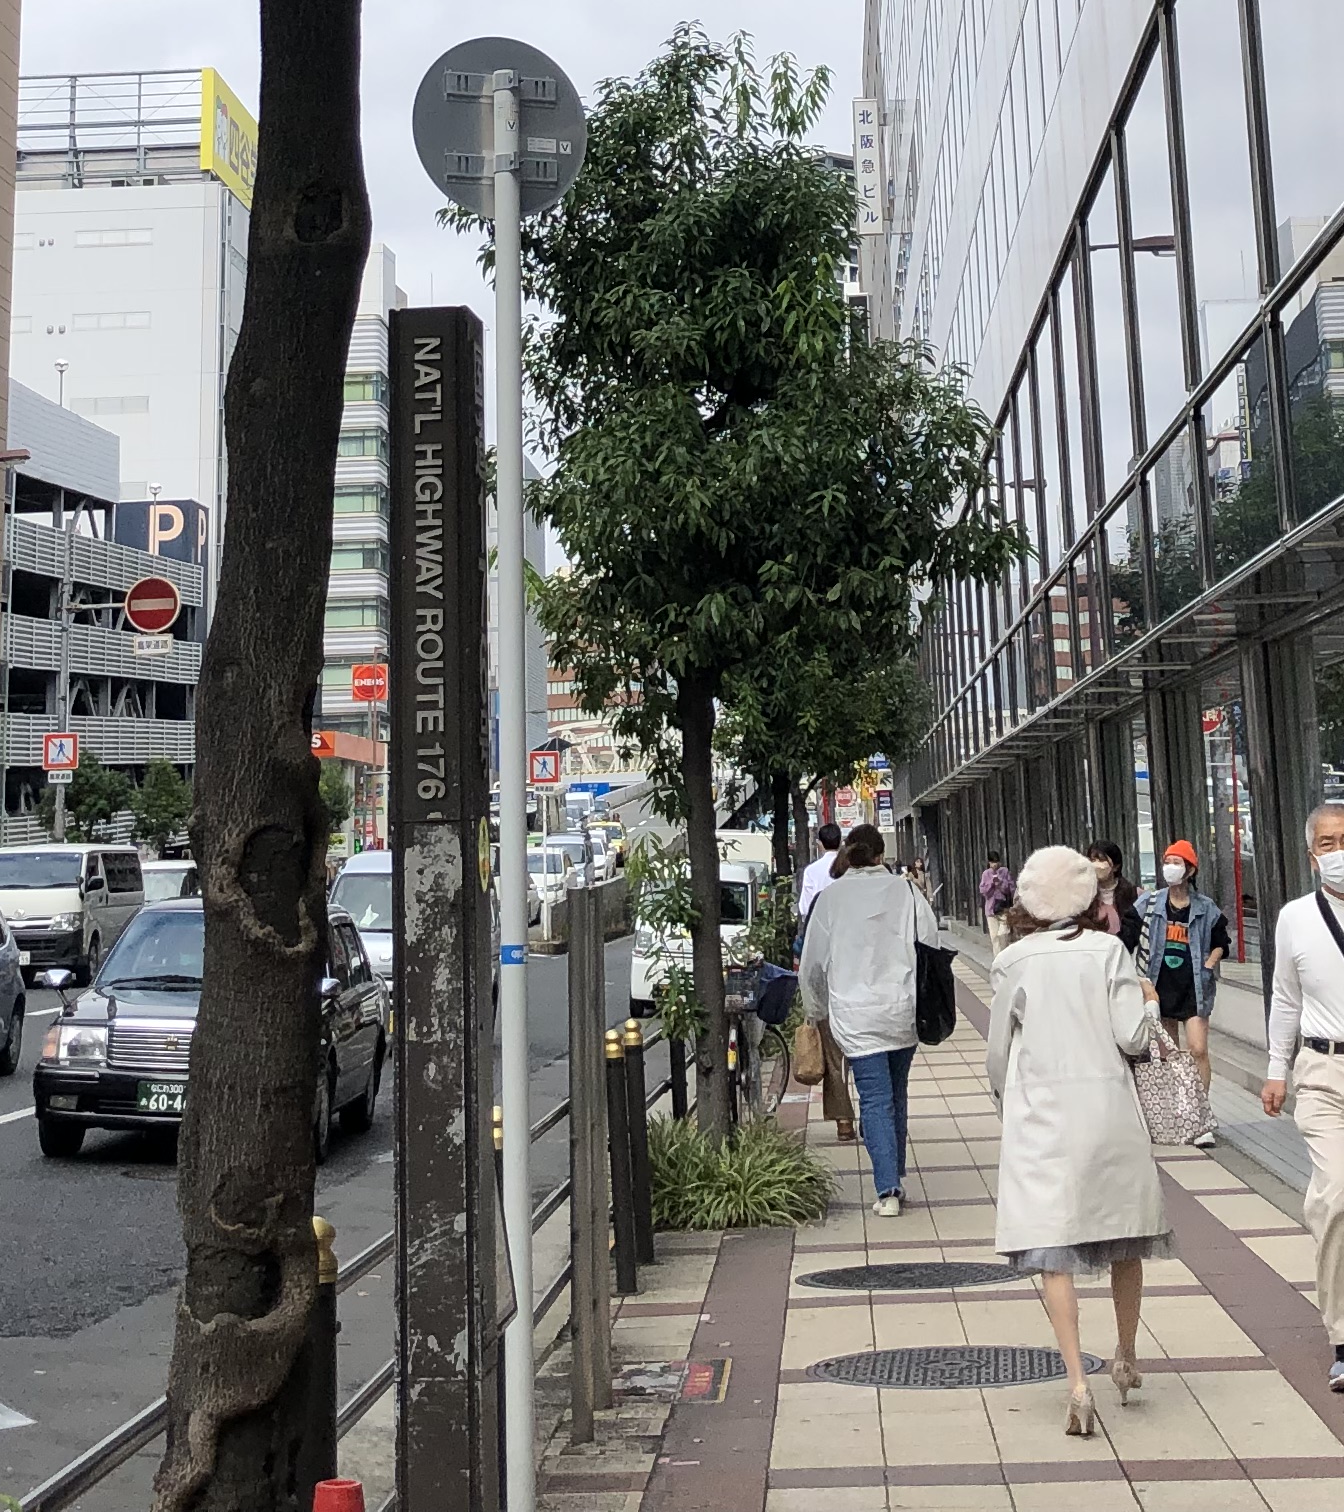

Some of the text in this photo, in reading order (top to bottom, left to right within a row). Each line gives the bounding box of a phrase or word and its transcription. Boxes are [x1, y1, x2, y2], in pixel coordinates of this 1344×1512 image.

[858, 109, 879, 224] 北阪急ビル
[147, 503, 184, 556] P
[413, 336, 447, 801] NAT'L HIGHWAY ROUTE 176
[149, 1093, 187, 1112] 60-4
